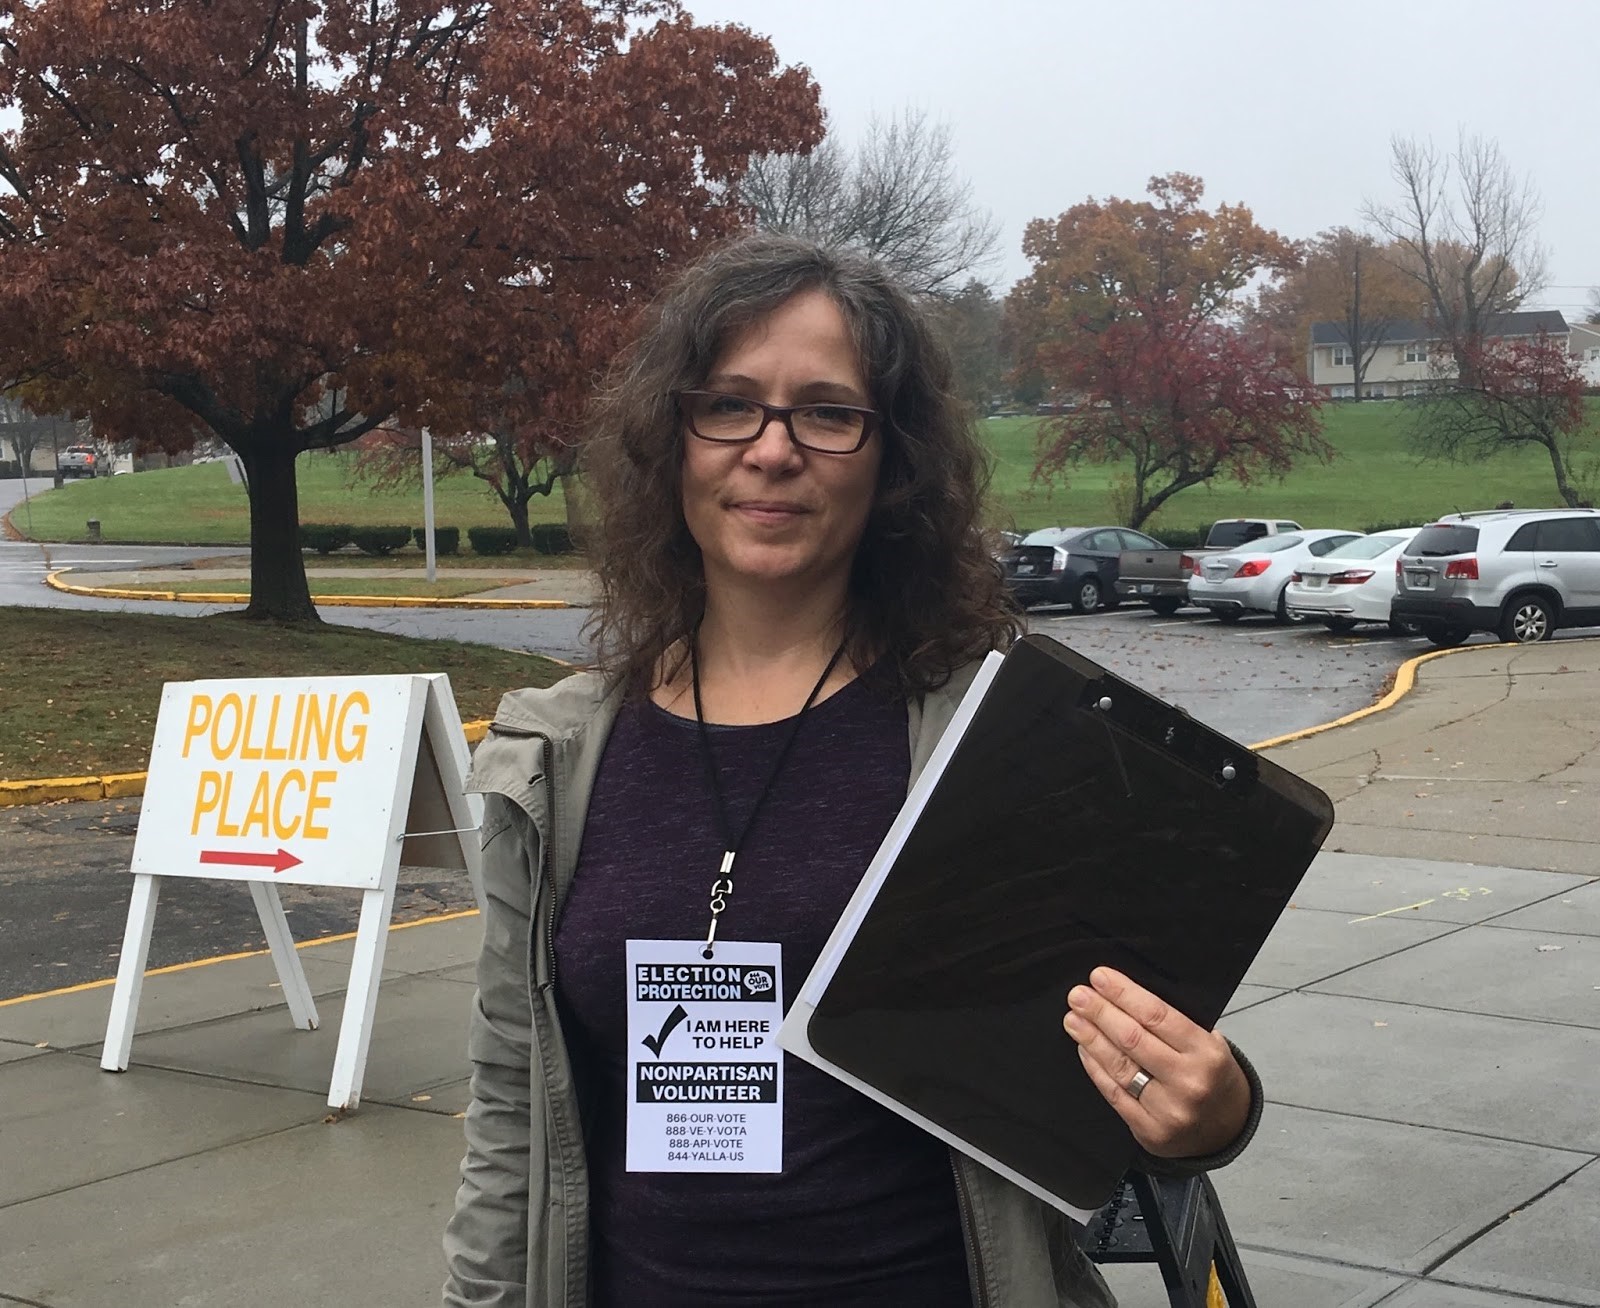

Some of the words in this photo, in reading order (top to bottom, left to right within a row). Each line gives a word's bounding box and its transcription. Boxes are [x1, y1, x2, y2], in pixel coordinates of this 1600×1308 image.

[181, 690, 370, 763] POLLING
[190, 768, 338, 841] PLACE
[638, 966, 741, 982] ELECTION
[748, 976, 768, 985] OUR
[638, 984, 742, 1000] PROTECTION
[687, 1020, 691, 1033] I
[694, 1020, 721, 1033] AM
[725, 1020, 770, 1033] HERE
[692, 1036, 716, 1049] TO
[720, 1036, 764, 1049] HELP
[640, 1065, 774, 1081] NONPARTISAN
[652, 1085, 761, 1101] VOLUNTEER
[666, 1113, 747, 1123] 866-OUR-VOTE
[665, 1126, 747, 1136] 888-VE-Y-VOTA
[669, 1138, 743, 1149] 888-API-VOTE
[667, 1151, 744, 1162] 844-YALLA-US
